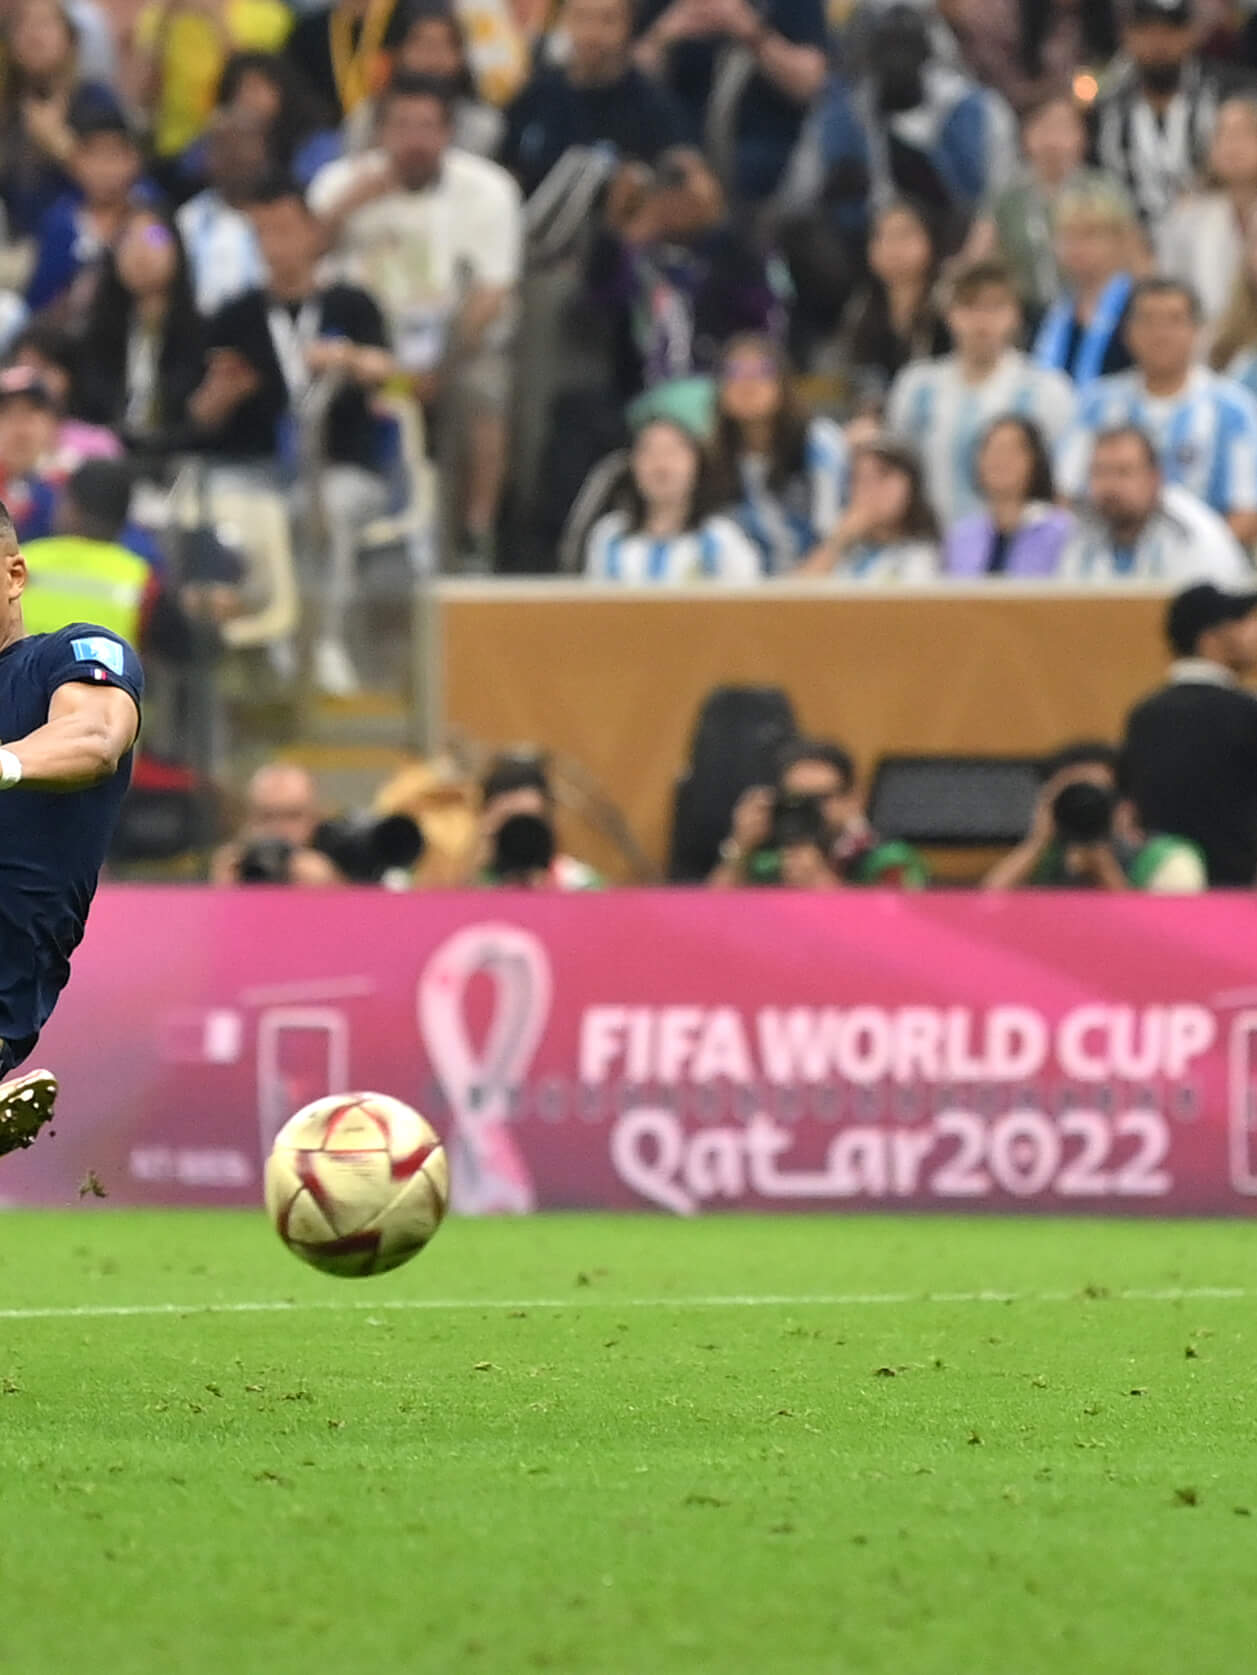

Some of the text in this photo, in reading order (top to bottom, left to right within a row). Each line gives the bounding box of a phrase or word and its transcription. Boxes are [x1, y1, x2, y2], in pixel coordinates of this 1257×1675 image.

[580, 1002, 1218, 1083] FIFA WORLD CUP
